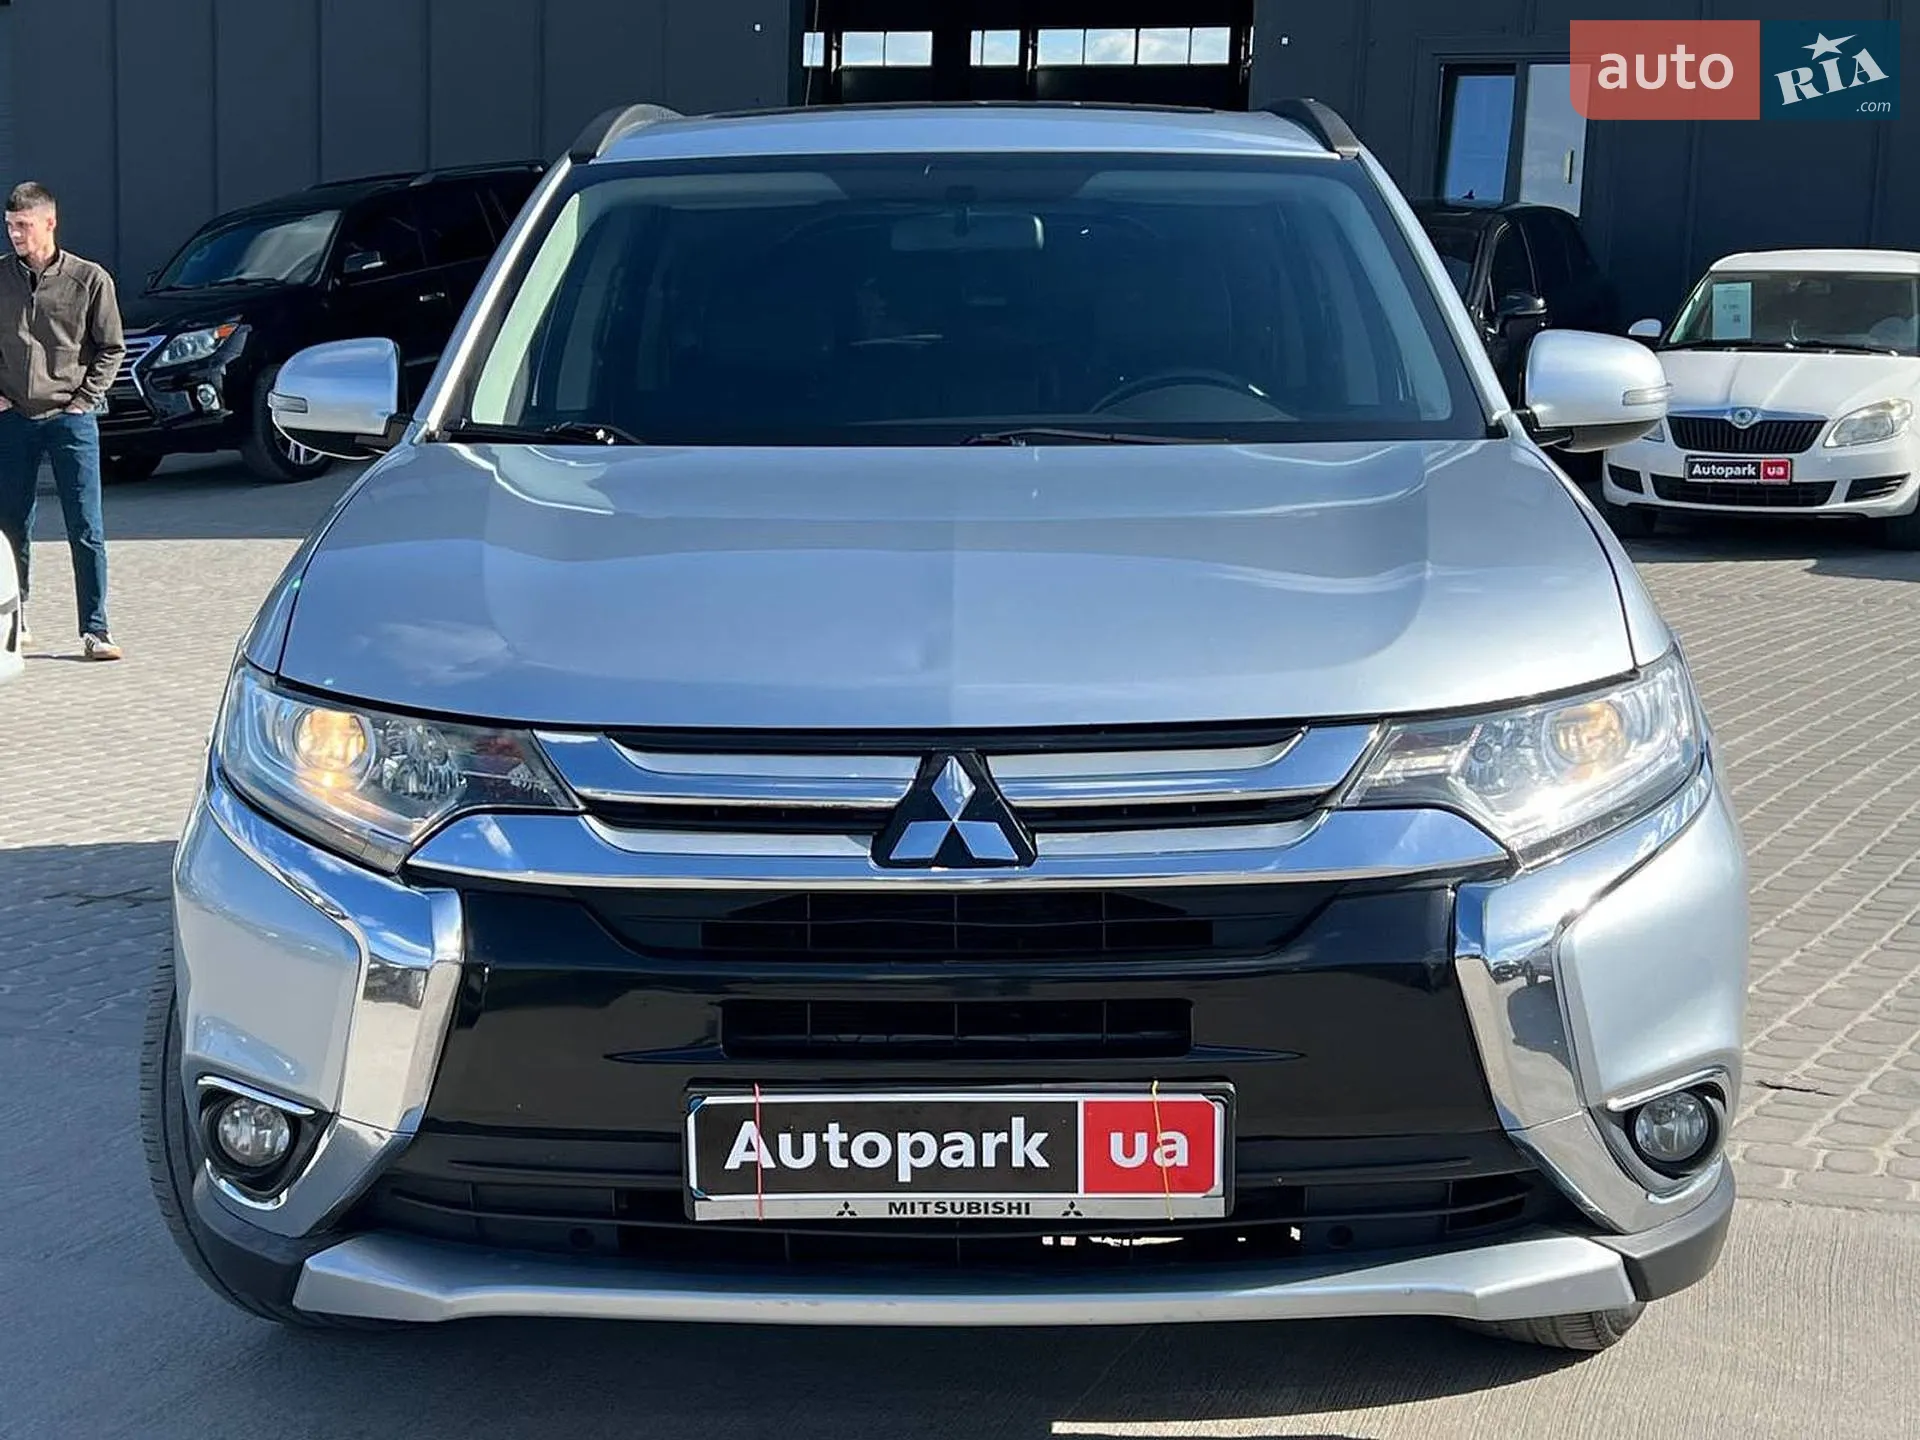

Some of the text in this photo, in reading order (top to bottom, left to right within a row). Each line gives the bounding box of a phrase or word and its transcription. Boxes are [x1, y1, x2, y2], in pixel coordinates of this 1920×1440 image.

[1692, 463, 1785, 478] Autopark ua
[724, 1116, 1189, 1184] Autopark ua
[888, 1200, 1031, 1216] MITSUBISHI
